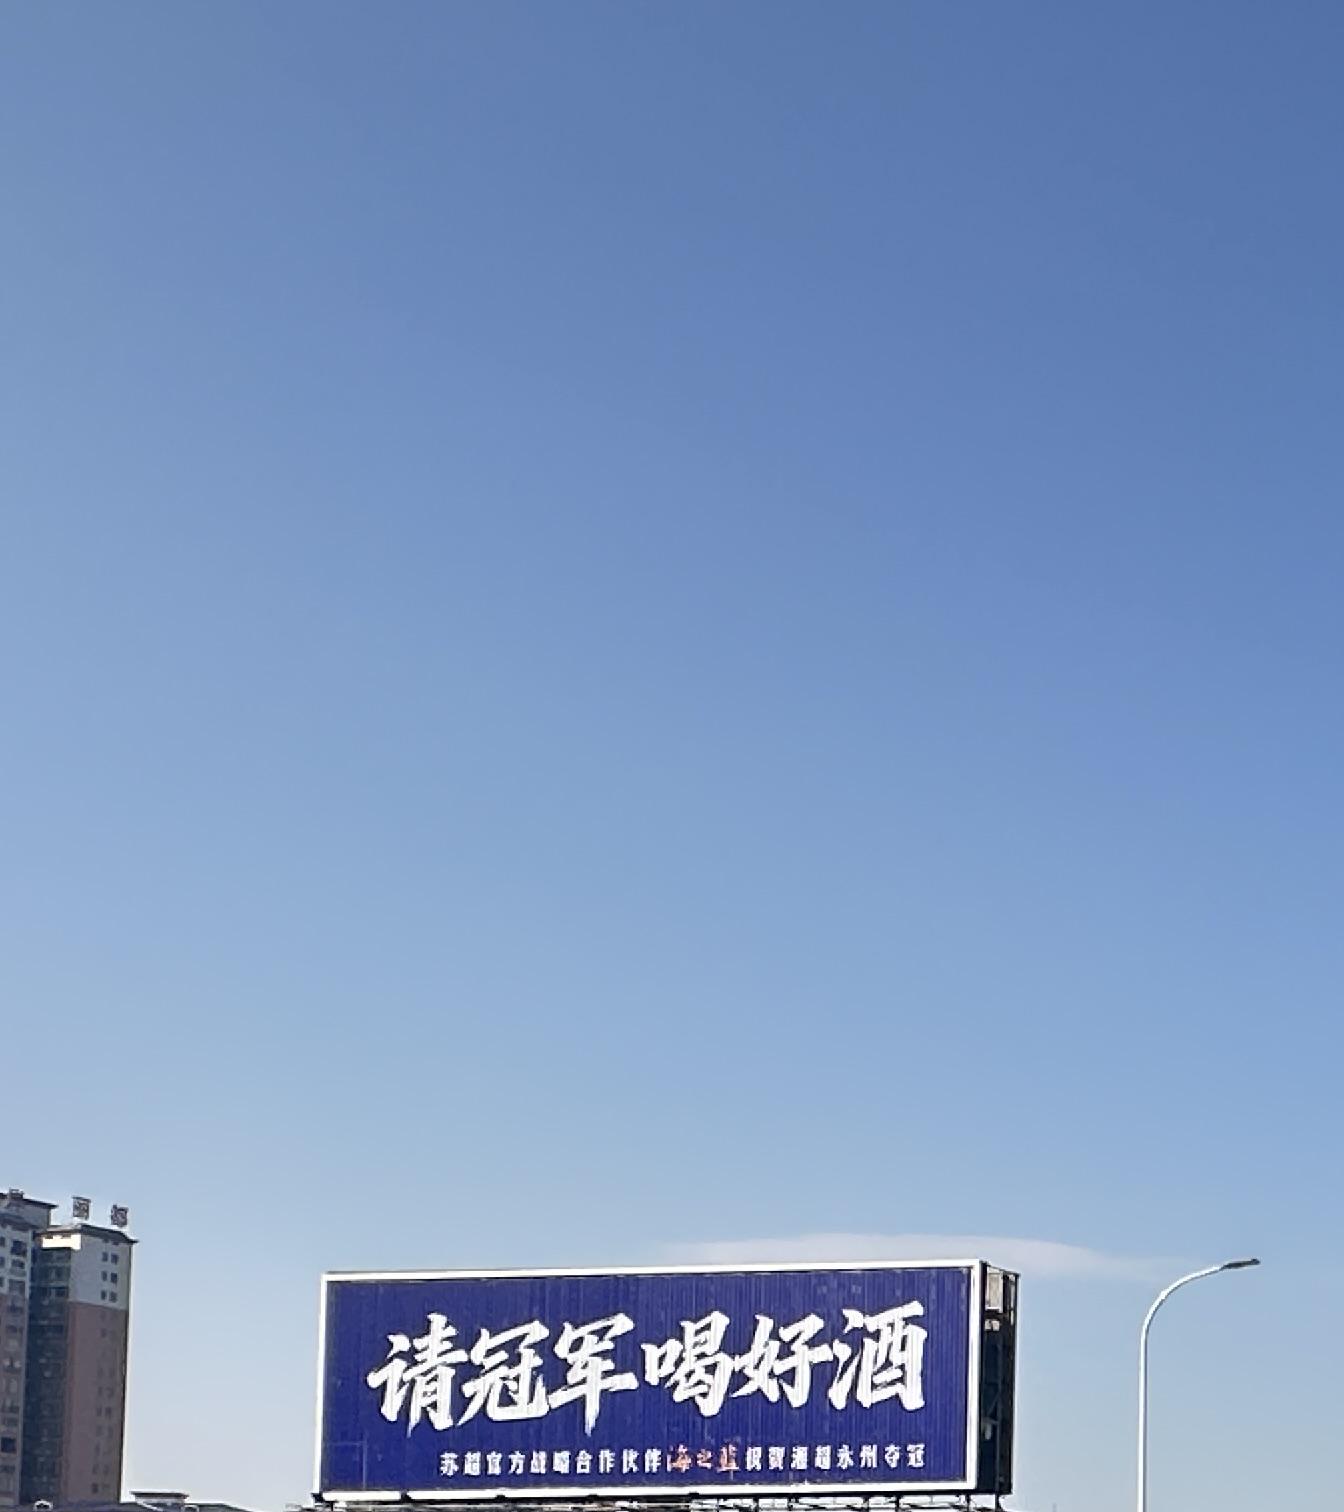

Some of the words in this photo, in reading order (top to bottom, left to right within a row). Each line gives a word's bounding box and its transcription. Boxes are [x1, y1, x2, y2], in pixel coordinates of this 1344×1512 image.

[366, 1300, 928, 1436] 请冠军喝好酒
